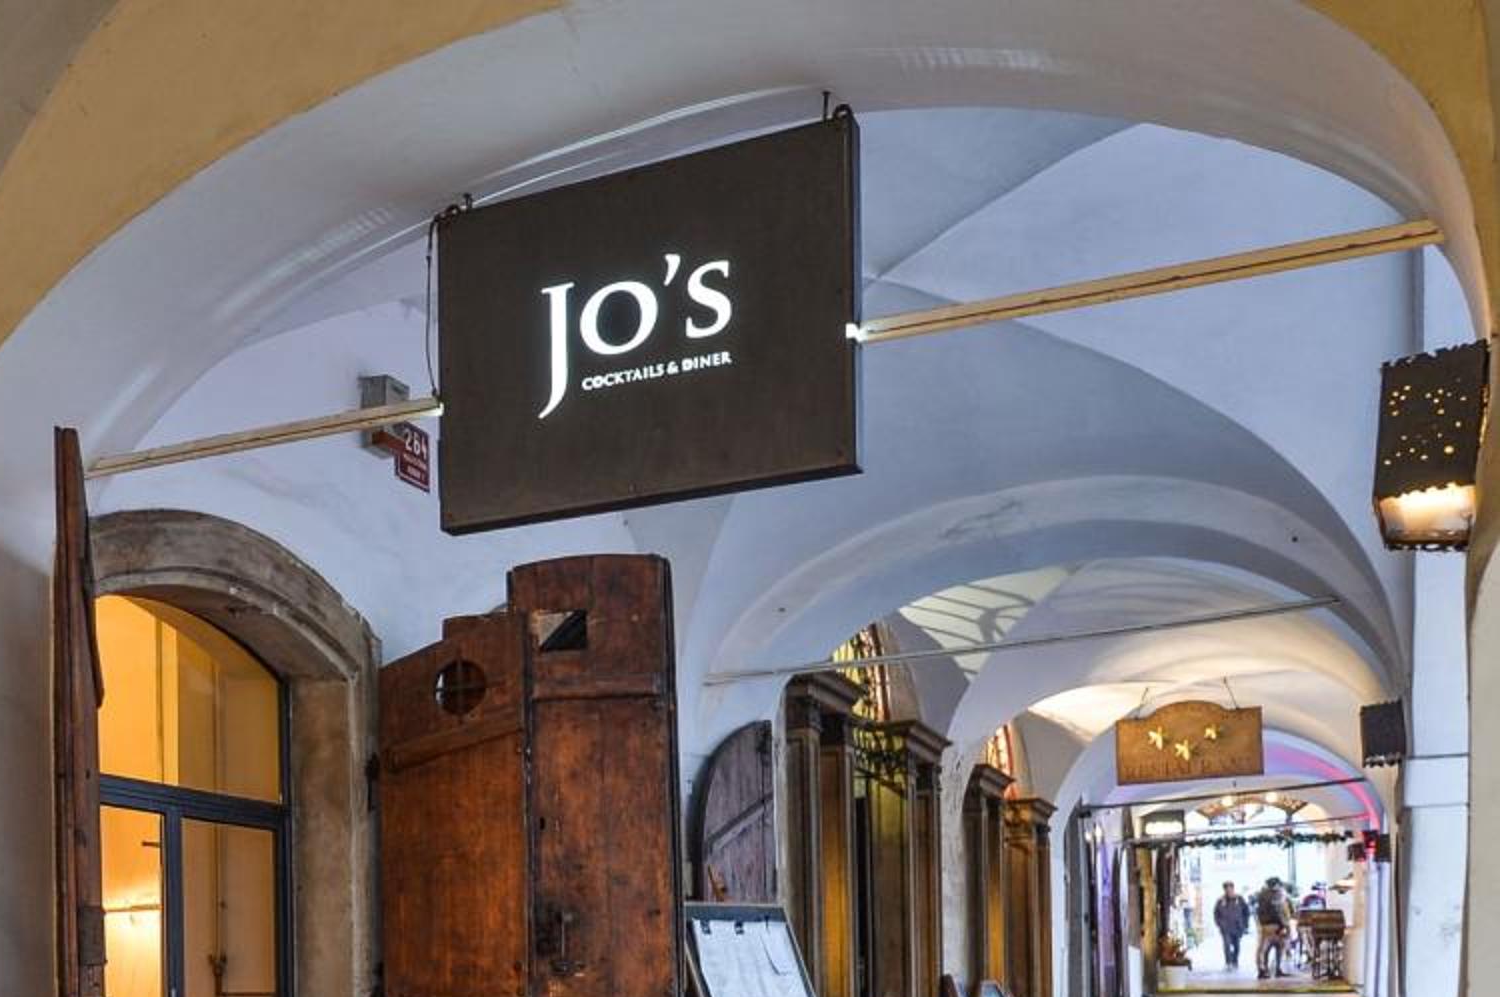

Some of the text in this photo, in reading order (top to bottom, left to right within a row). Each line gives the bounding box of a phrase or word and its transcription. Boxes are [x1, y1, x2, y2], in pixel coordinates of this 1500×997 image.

[538, 254, 733, 419] JO'S
[581, 351, 733, 391] COCKTAILS & DINER
